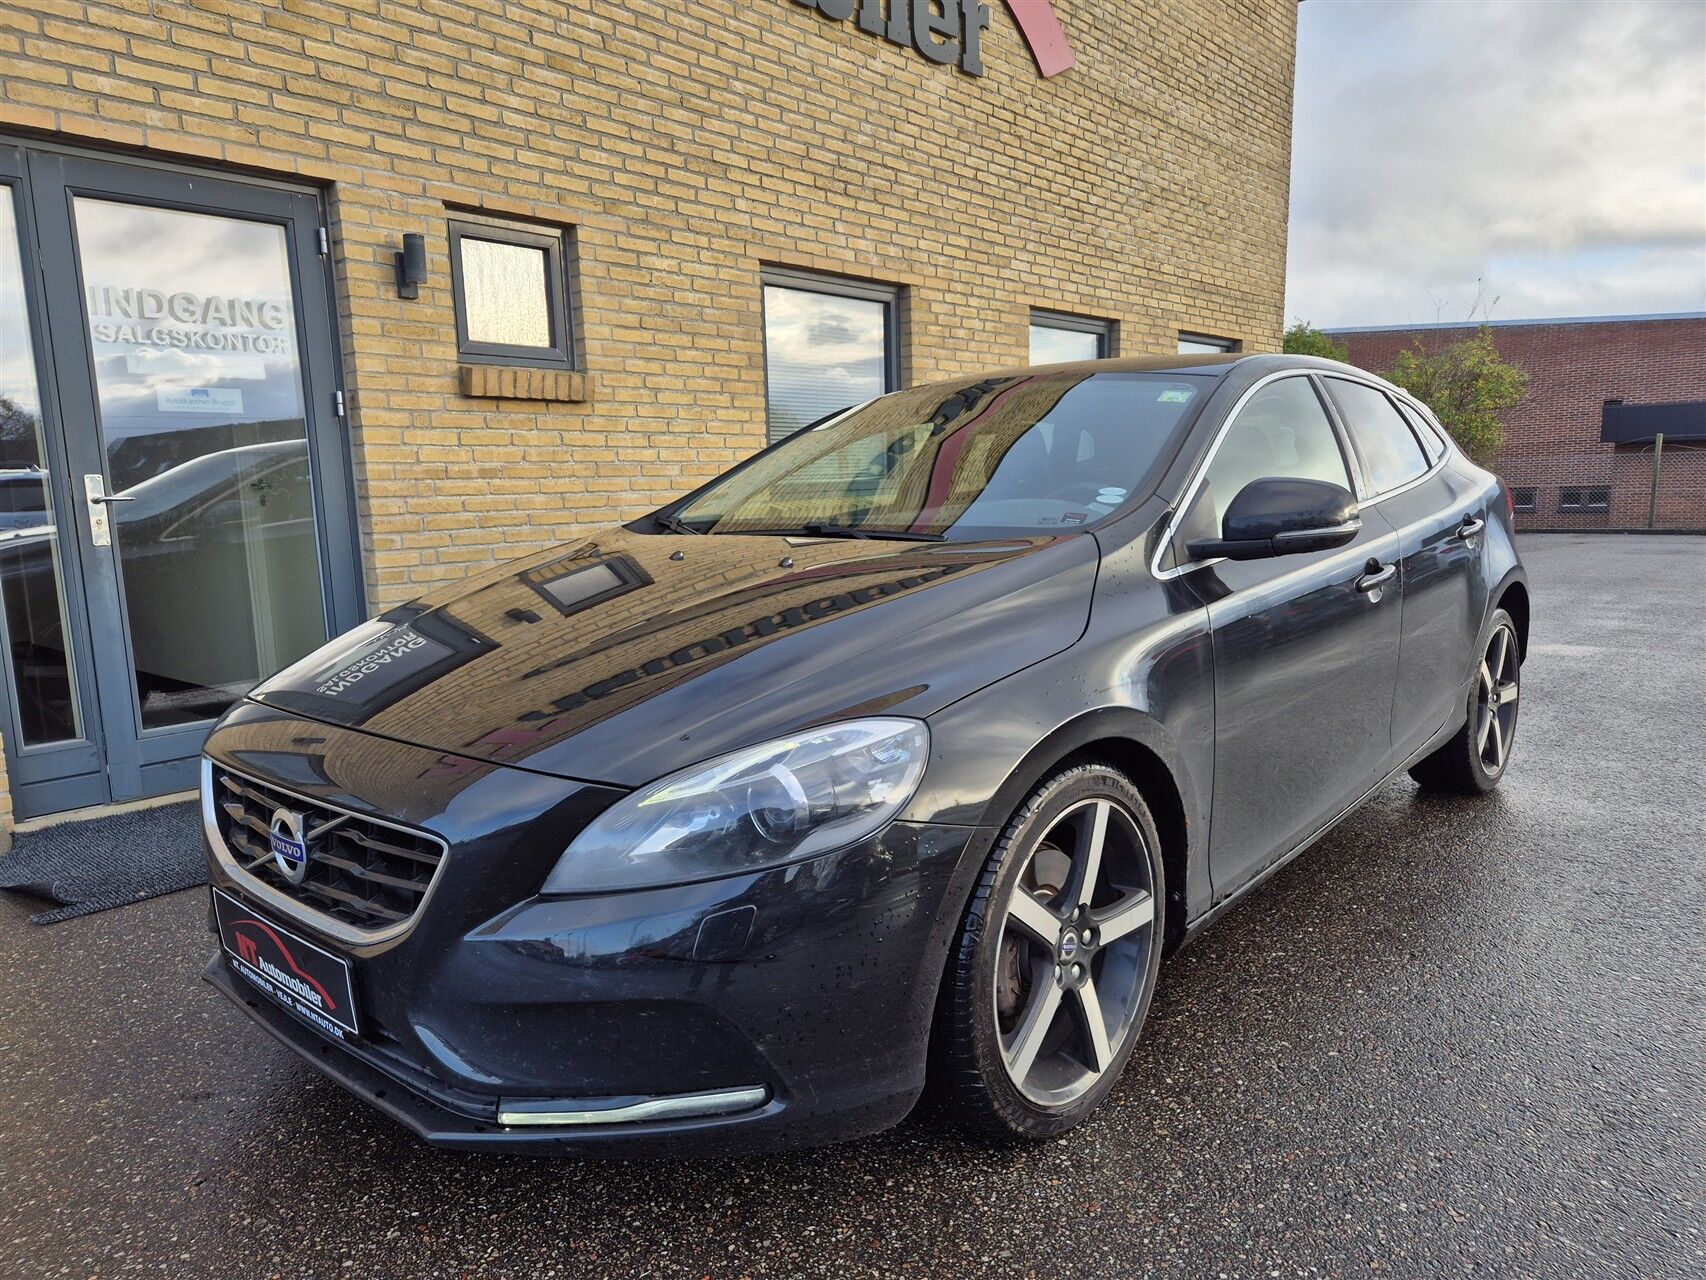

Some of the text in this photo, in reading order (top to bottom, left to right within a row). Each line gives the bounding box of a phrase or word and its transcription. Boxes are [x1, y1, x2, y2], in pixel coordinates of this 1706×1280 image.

[88, 286, 285, 330] INDGANG
[94, 323, 290, 354] SALGSKONTOR
[271, 836, 301, 857] VOLVO
[235, 931, 323, 1008] NT Automobiler
